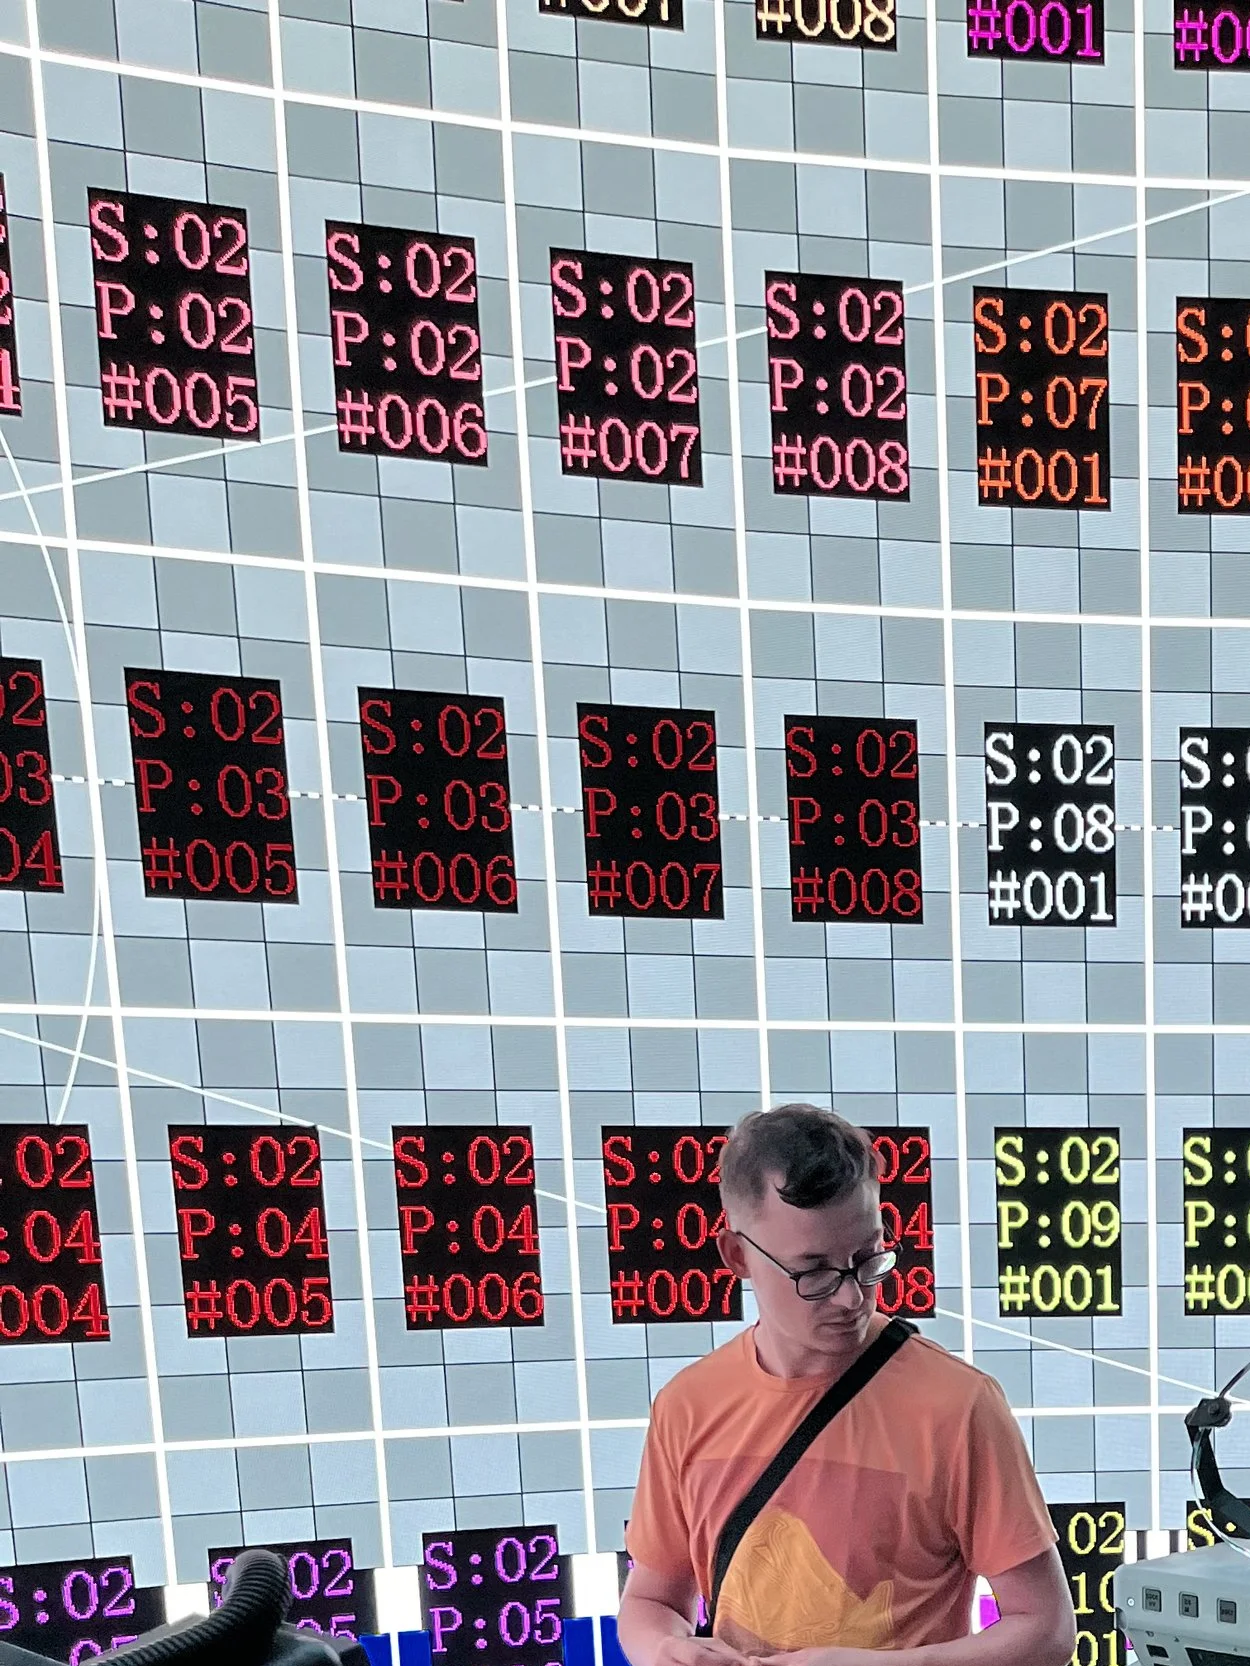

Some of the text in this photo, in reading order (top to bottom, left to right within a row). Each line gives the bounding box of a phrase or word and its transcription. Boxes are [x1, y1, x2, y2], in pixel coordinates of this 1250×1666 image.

[968, 0, 1101, 54] #001
[92, 200, 247, 276] S:02
[329, 232, 475, 303] S:02
[553, 259, 693, 328] S:02
[97, 280, 252, 355] P:02
[768, 281, 902, 345] S:02
[975, 297, 1107, 357] S:02
[333, 309, 479, 381] P:02
[556, 335, 696, 404] P:02
[102, 362, 256, 433] #005
[770, 357, 904, 420] P:02
[977, 372, 1107, 430] P:07
[337, 388, 482, 458] #006
[560, 413, 697, 479] #007
[773, 433, 906, 494] #008
[978, 446, 1108, 504] #001
[130, 680, 282, 745] S:02
[363, 699, 505, 760] S:02
[580, 714, 715, 771] S:02
[787, 726, 916, 779] S:02
[986, 731, 1113, 786] S:02
[136, 758, 287, 821] P:03
[367, 774, 509, 833] P:03
[584, 787, 718, 842] P:03
[789, 796, 918, 848] P:03
[987, 801, 1114, 853] P:08
[143, 836, 293, 896] #005
[373, 849, 513, 905] #006
[588, 859, 719, 912] #007
[792, 866, 919, 917] #008
[989, 869, 1114, 921] #001
[174, 1135, 318, 1190] S:02
[397, 1135, 532, 1188] S:02
[997, 1136, 1118, 1187] S:02
[179, 1207, 324, 1259] P:04
[400, 1204, 535, 1254] P:04
[998, 1200, 1119, 1249] P:09
[185, 1276, 328, 1330] #005
[405, 1271, 539, 1323] #006
[611, 1268, 738, 1318] #007
[1000, 1264, 1120, 1312] #001
[424, 1534, 559, 1591] S:02
[428, 1598, 562, 1653] P:05
